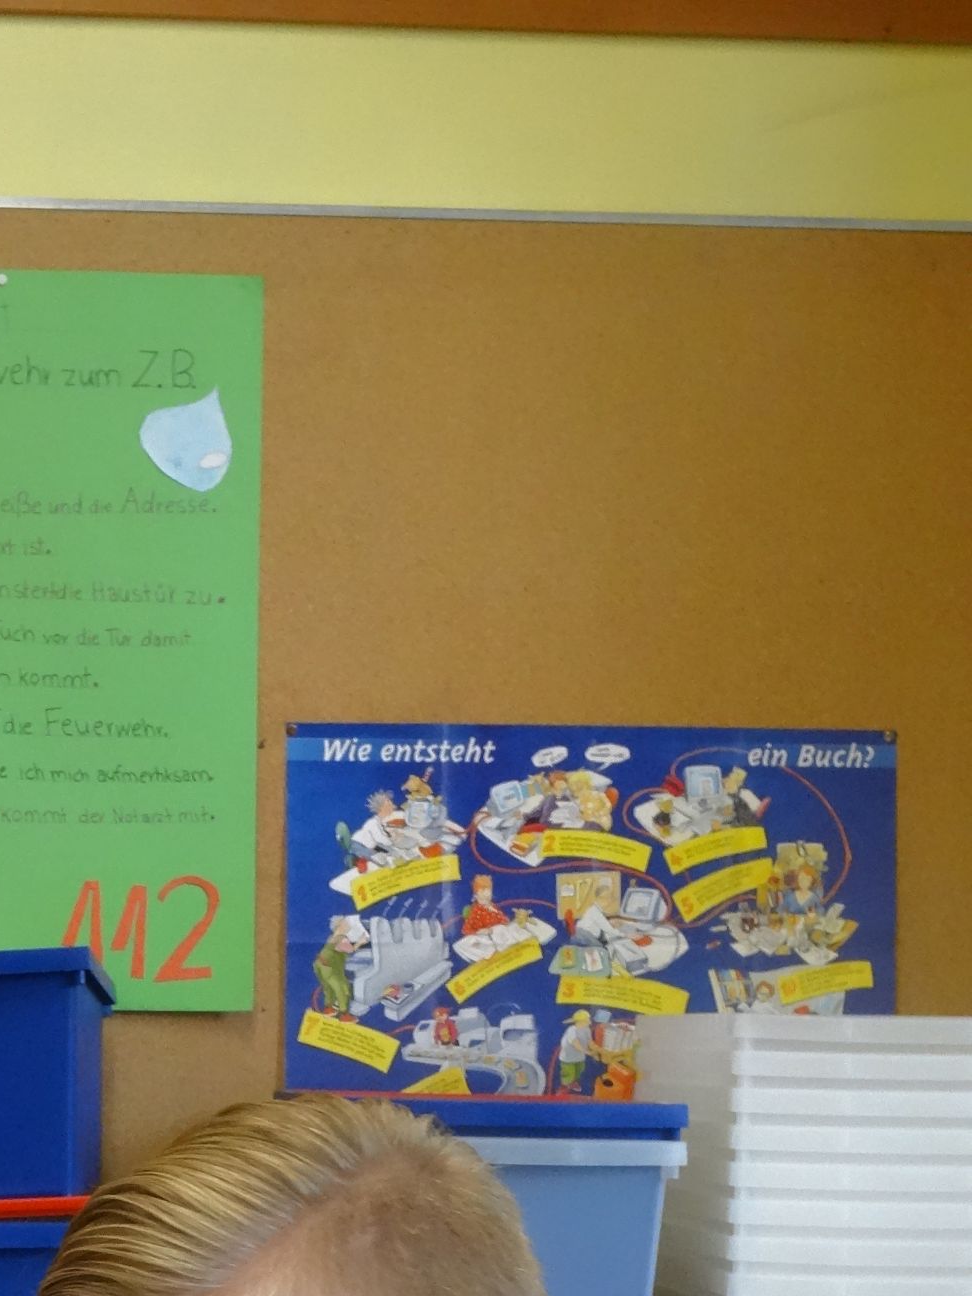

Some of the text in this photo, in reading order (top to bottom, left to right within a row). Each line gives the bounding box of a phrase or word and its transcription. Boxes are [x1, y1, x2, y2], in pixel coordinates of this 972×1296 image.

[61, 368, 122, 388] zum
[47, 492, 82, 516] und
[77, 628, 100, 646] die
[140, 629, 192, 648] damit
[19, 666, 100, 689] kommt.
[3, 714, 34, 736] die
[323, 738, 876, 770] Wie entsteht ein Buch?
[19, 763, 44, 782] ich
[51, 767, 89, 783] mich
[0, 807, 66, 824] kommt
[61, 875, 221, 984] 112
